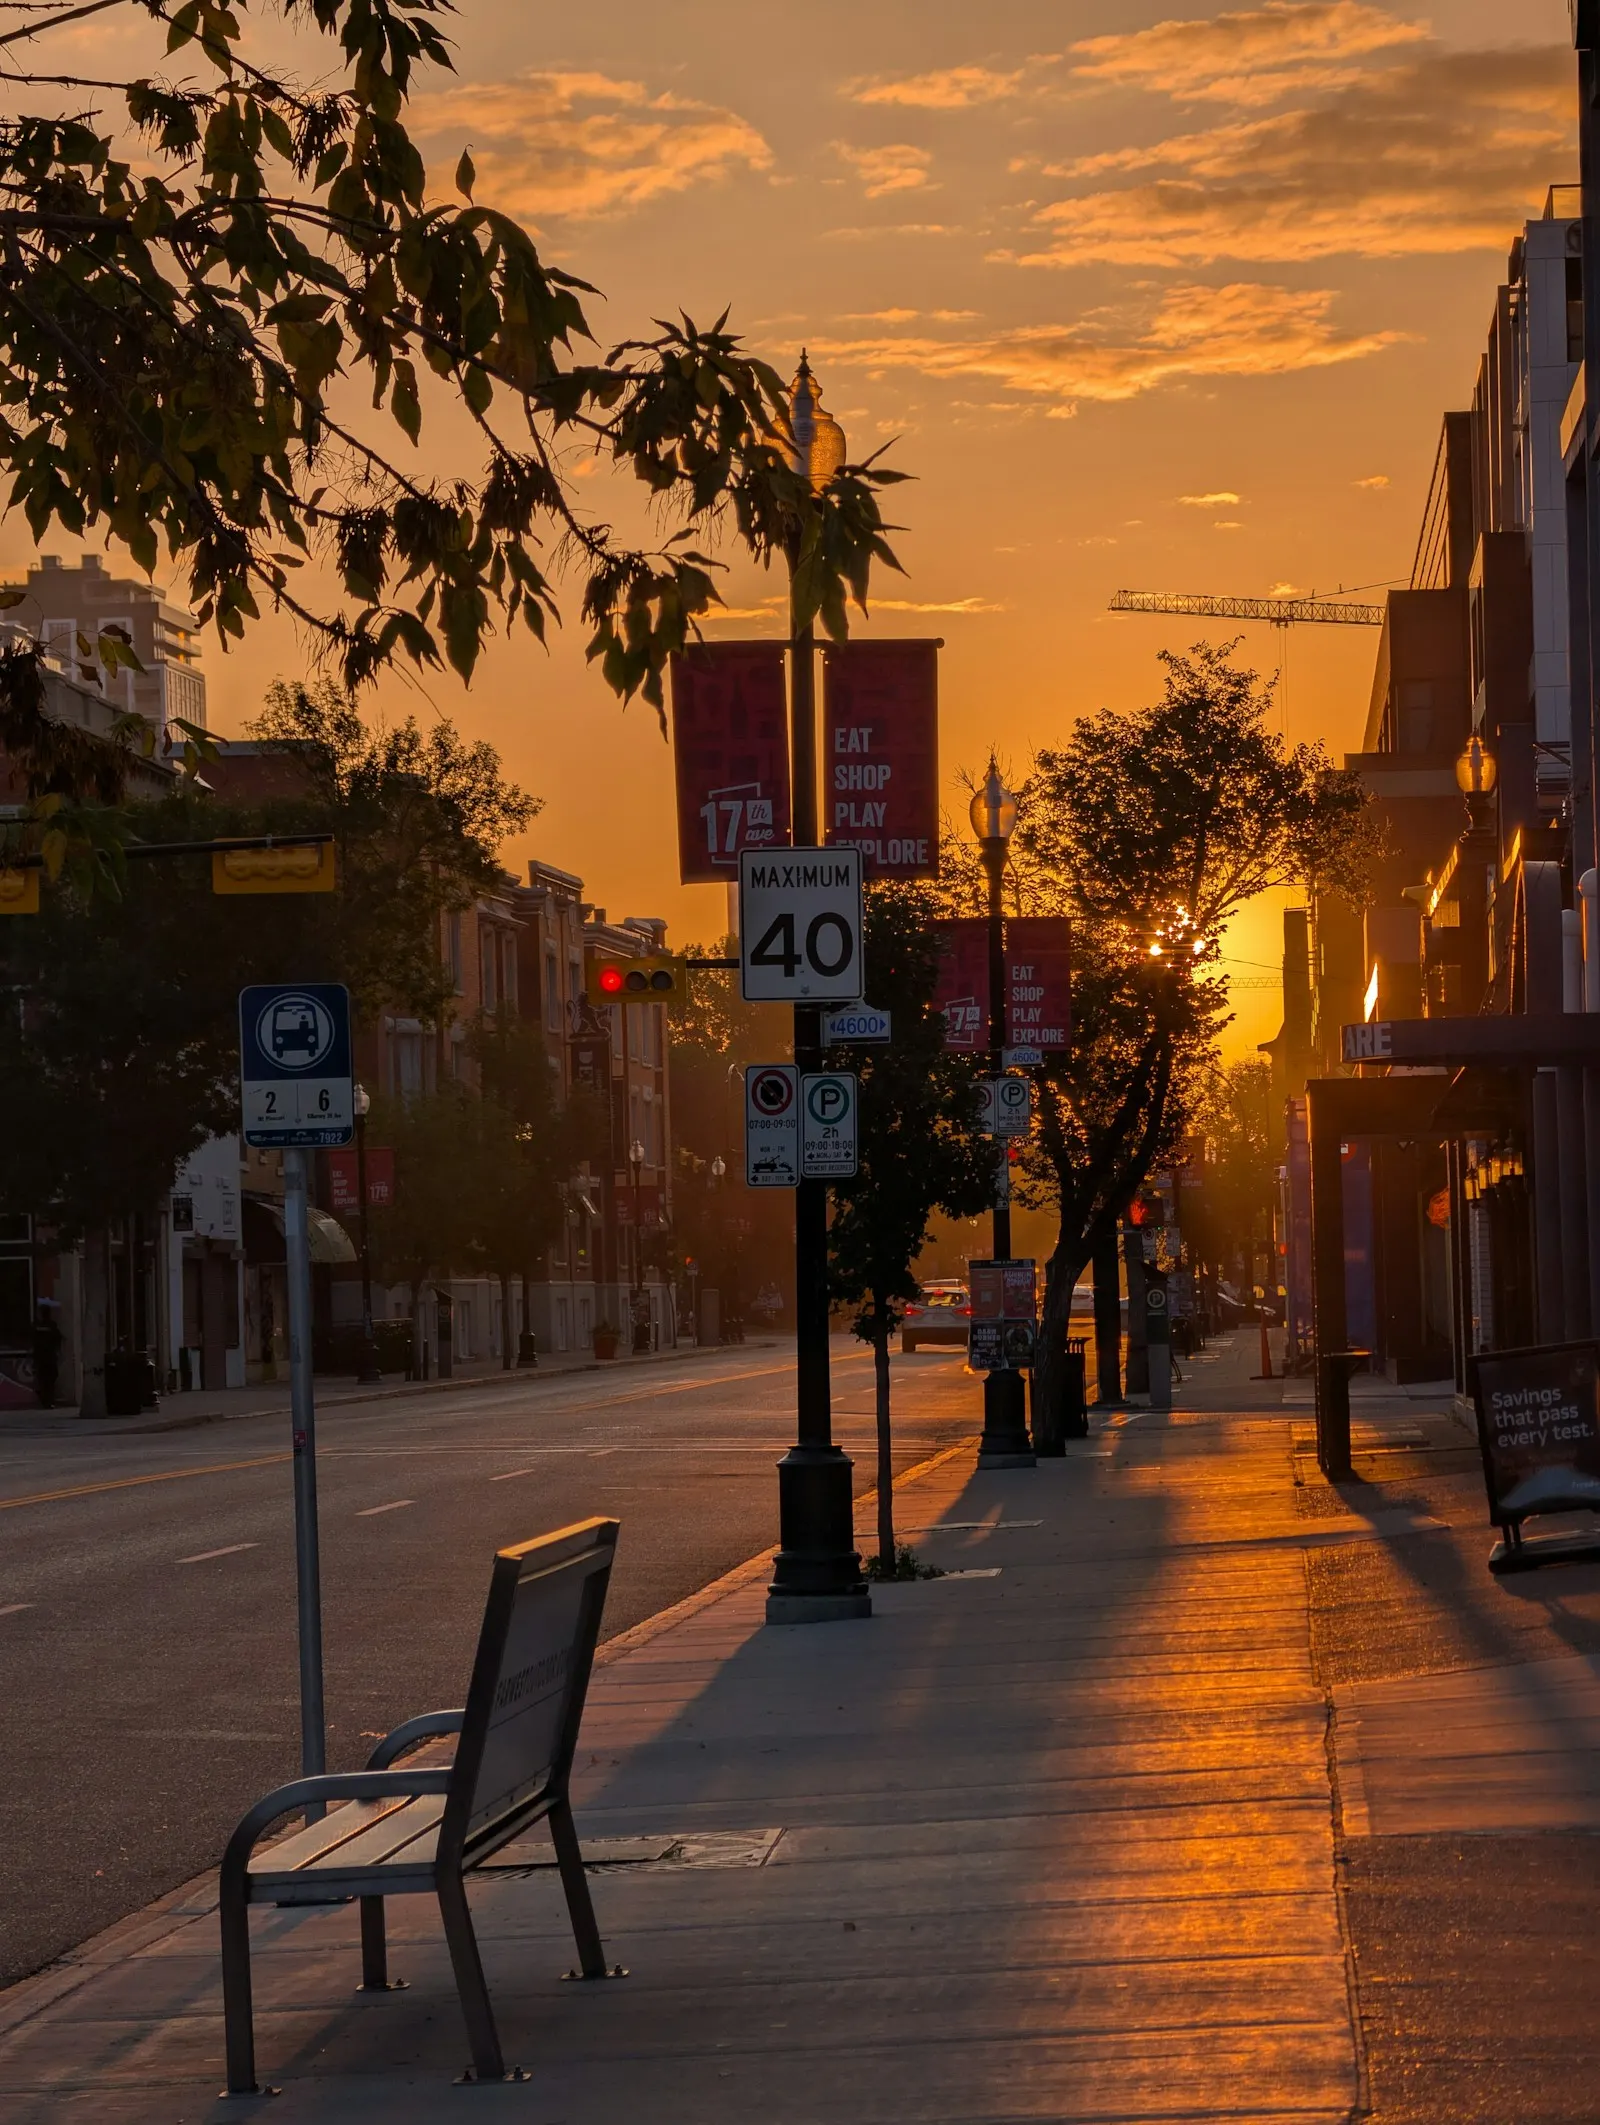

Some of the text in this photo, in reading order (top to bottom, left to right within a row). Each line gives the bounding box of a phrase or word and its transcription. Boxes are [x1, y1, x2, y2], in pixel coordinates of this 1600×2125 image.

[834, 727, 873, 753] EAT
[834, 764, 892, 791] SHOP
[834, 801, 888, 828] PLAY
[835, 838, 929, 865] PLORE
[751, 864, 850, 889] MAXIMUM
[750, 911, 854, 978] 40
[1011, 965, 1035, 981] EAT
[1011, 986, 1045, 1002] SHOP
[836, 1016, 879, 1034] 4600
[1011, 1007, 1042, 1023] PLAY
[1011, 1028, 1065, 1044] EXPLORE
[1011, 1051, 1036, 1061] 4600
[265, 1091, 277, 1114] 2
[318, 1088, 330, 1112] 6
[749, 1120, 796, 1130] 07:00-09:00
[822, 1127, 839, 1139] 2h
[320, 1131, 343, 1144] 7922
[1491, 1387, 1562, 1409] Savings
[1495, 1405, 1579, 1428] that pass
[1497, 1421, 1594, 1448] every test.
